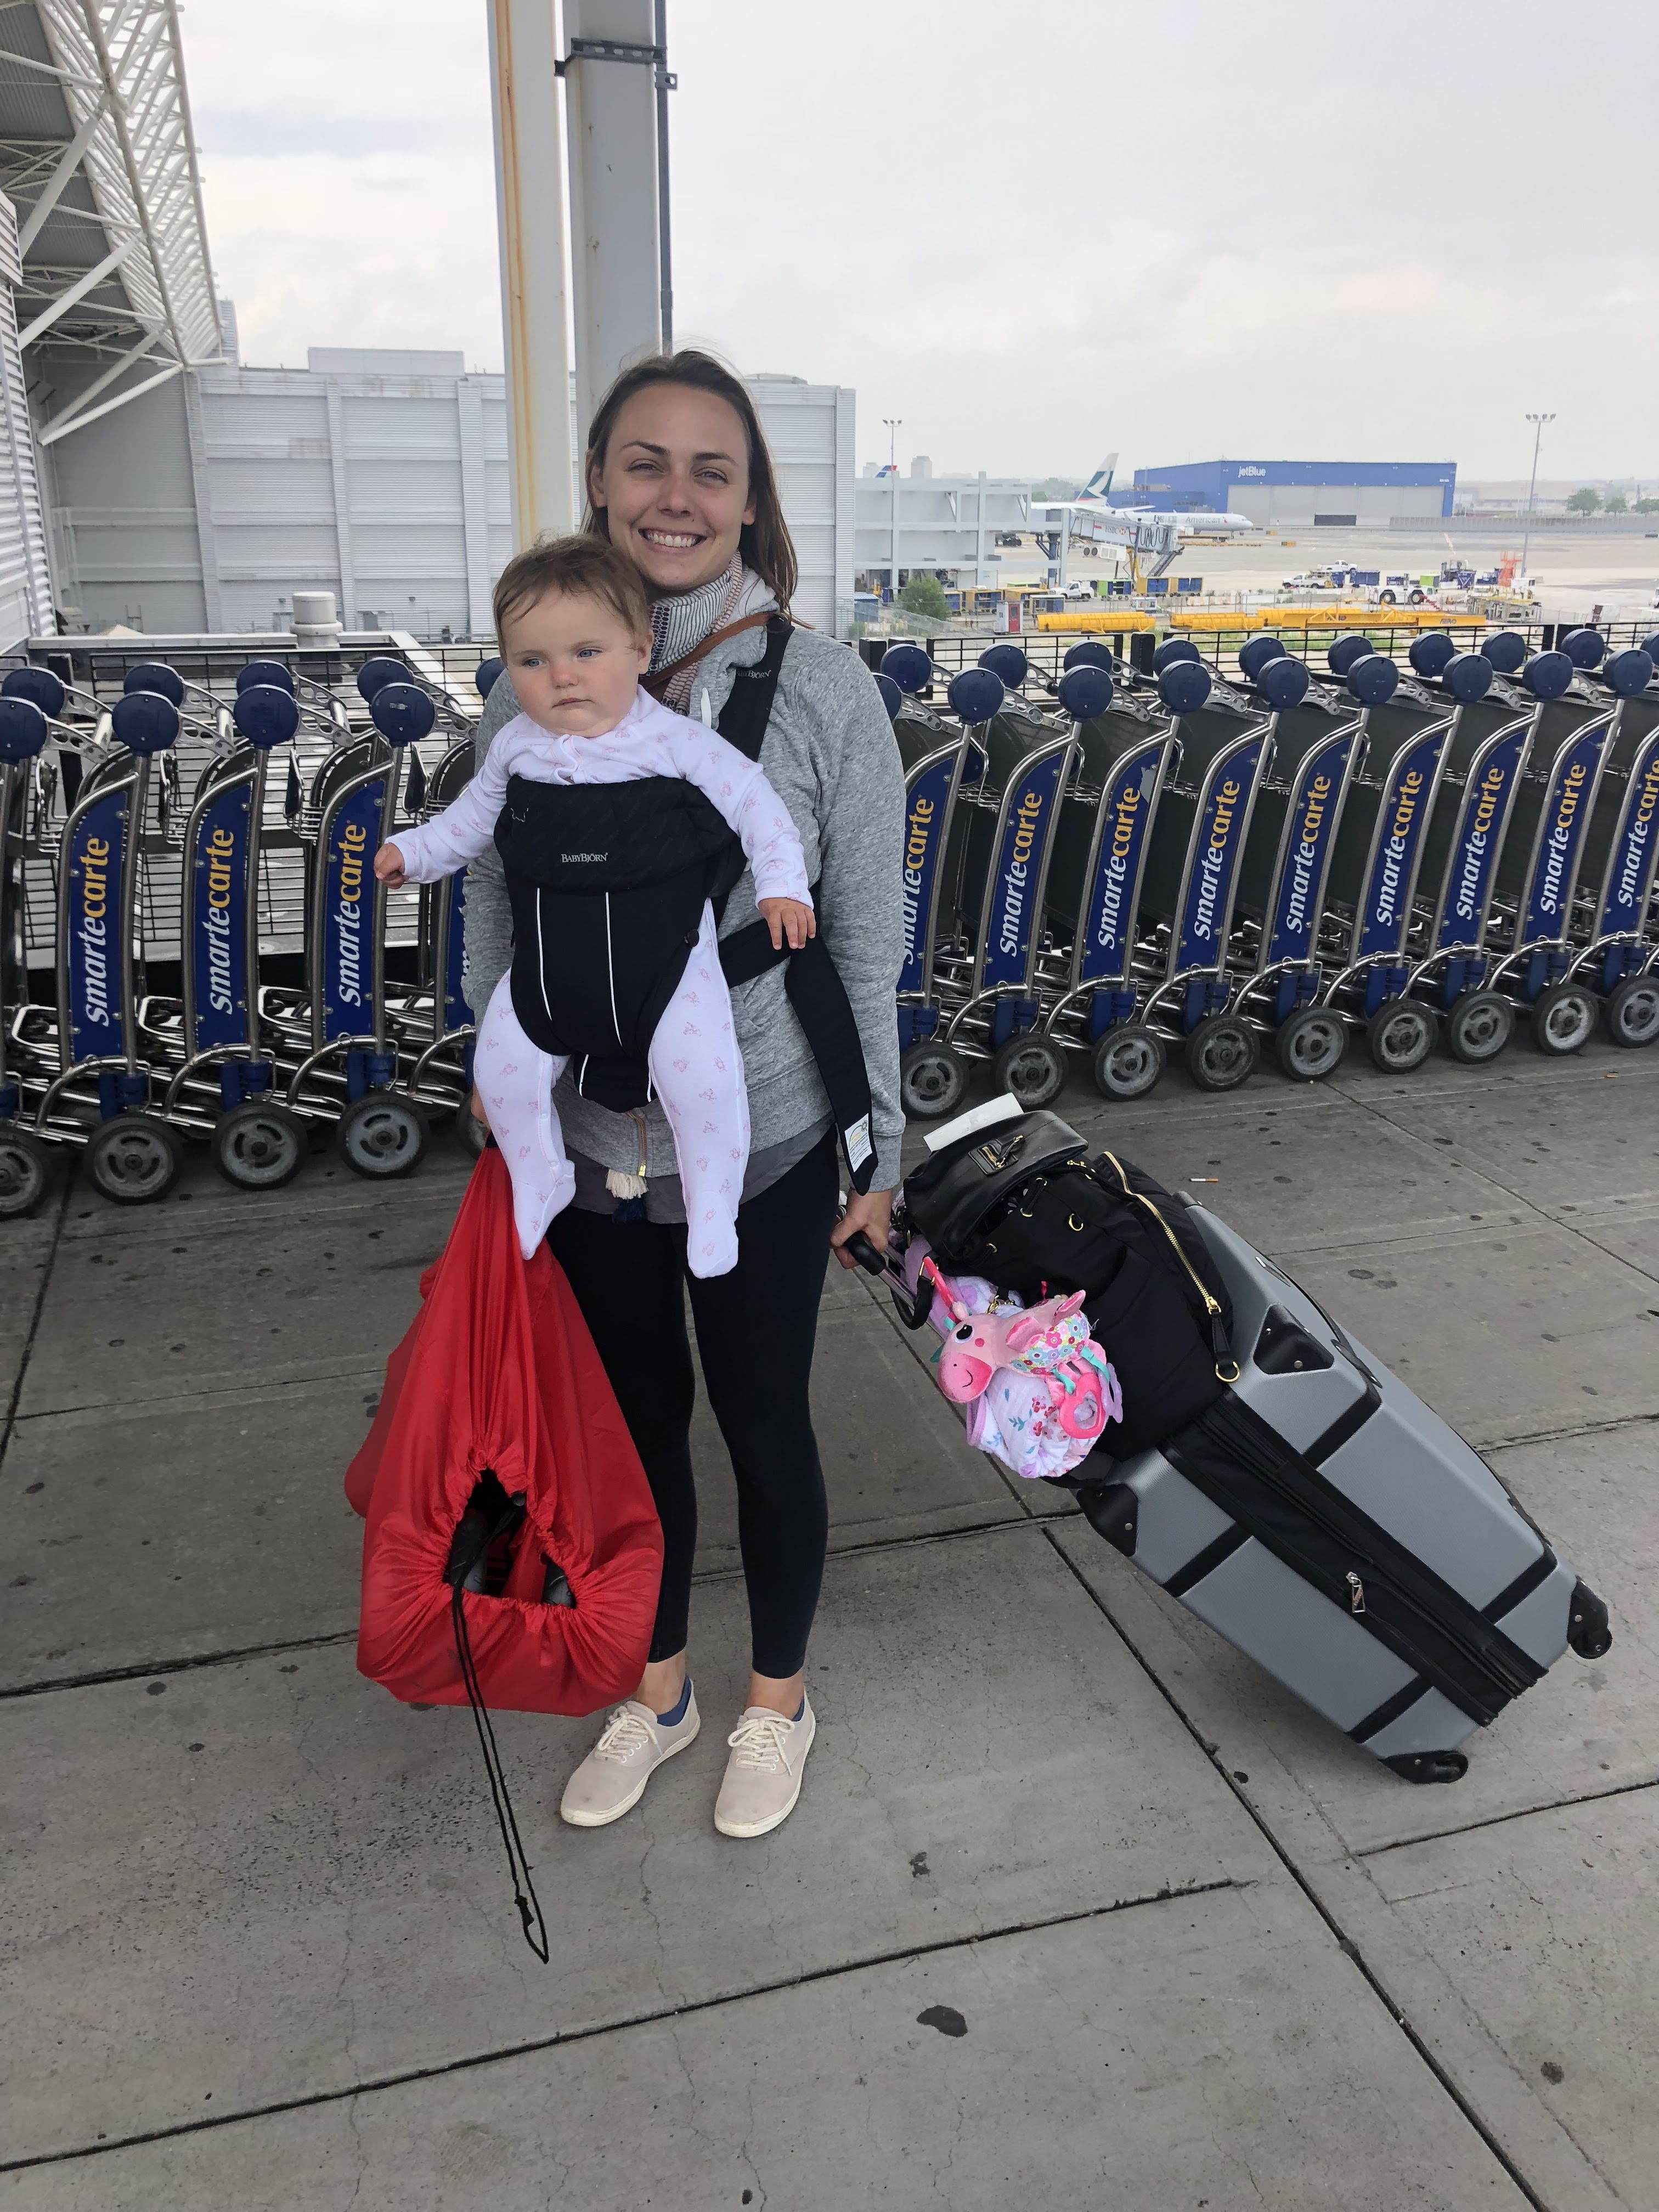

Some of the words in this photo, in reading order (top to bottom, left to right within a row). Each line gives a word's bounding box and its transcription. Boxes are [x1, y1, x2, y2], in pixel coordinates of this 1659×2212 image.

[1238, 466, 1266, 478] jetBlue
[334, 825, 365, 1007] smartecarte
[561, 853, 607, 862] BABYBJÖRN
[1000, 793, 1043, 957] smartecarte
[1097, 787, 1141, 950] smartecarte
[1193, 780, 1240, 940] smartecarte
[1286, 776, 1331, 933] smartecarte
[1376, 771, 1423, 927] smartecarte
[1456, 768, 1504, 920] smartecarte
[1541, 765, 1586, 915] smartecarte
[78, 838, 109, 1026] smartecarte
[203, 830, 233, 1014] smartecarte
